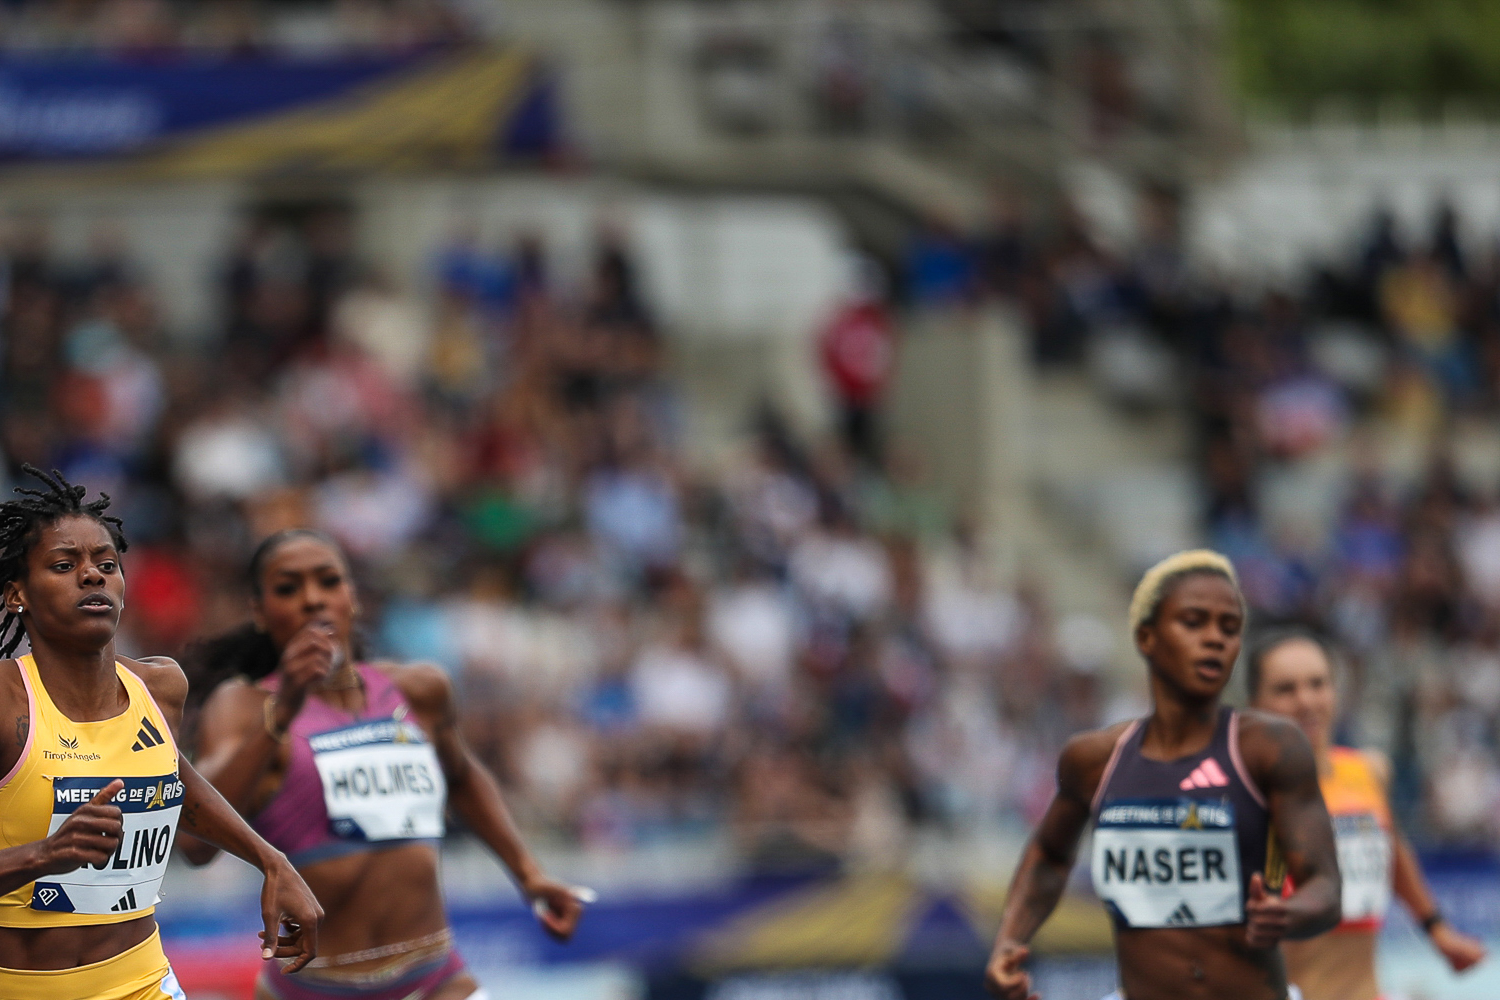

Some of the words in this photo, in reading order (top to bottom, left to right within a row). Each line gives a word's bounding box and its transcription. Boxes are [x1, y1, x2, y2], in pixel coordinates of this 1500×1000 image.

[43, 750, 72, 761] Tirop's
[74, 752, 101, 761] Angels
[56, 788, 127, 804] MEETG
[129, 788, 144, 802] DE
[144, 780, 185, 809] PARIS
[330, 763, 435, 799] HOLMES
[79, 824, 171, 871] LINO
[1104, 847, 1227, 882] NASER
